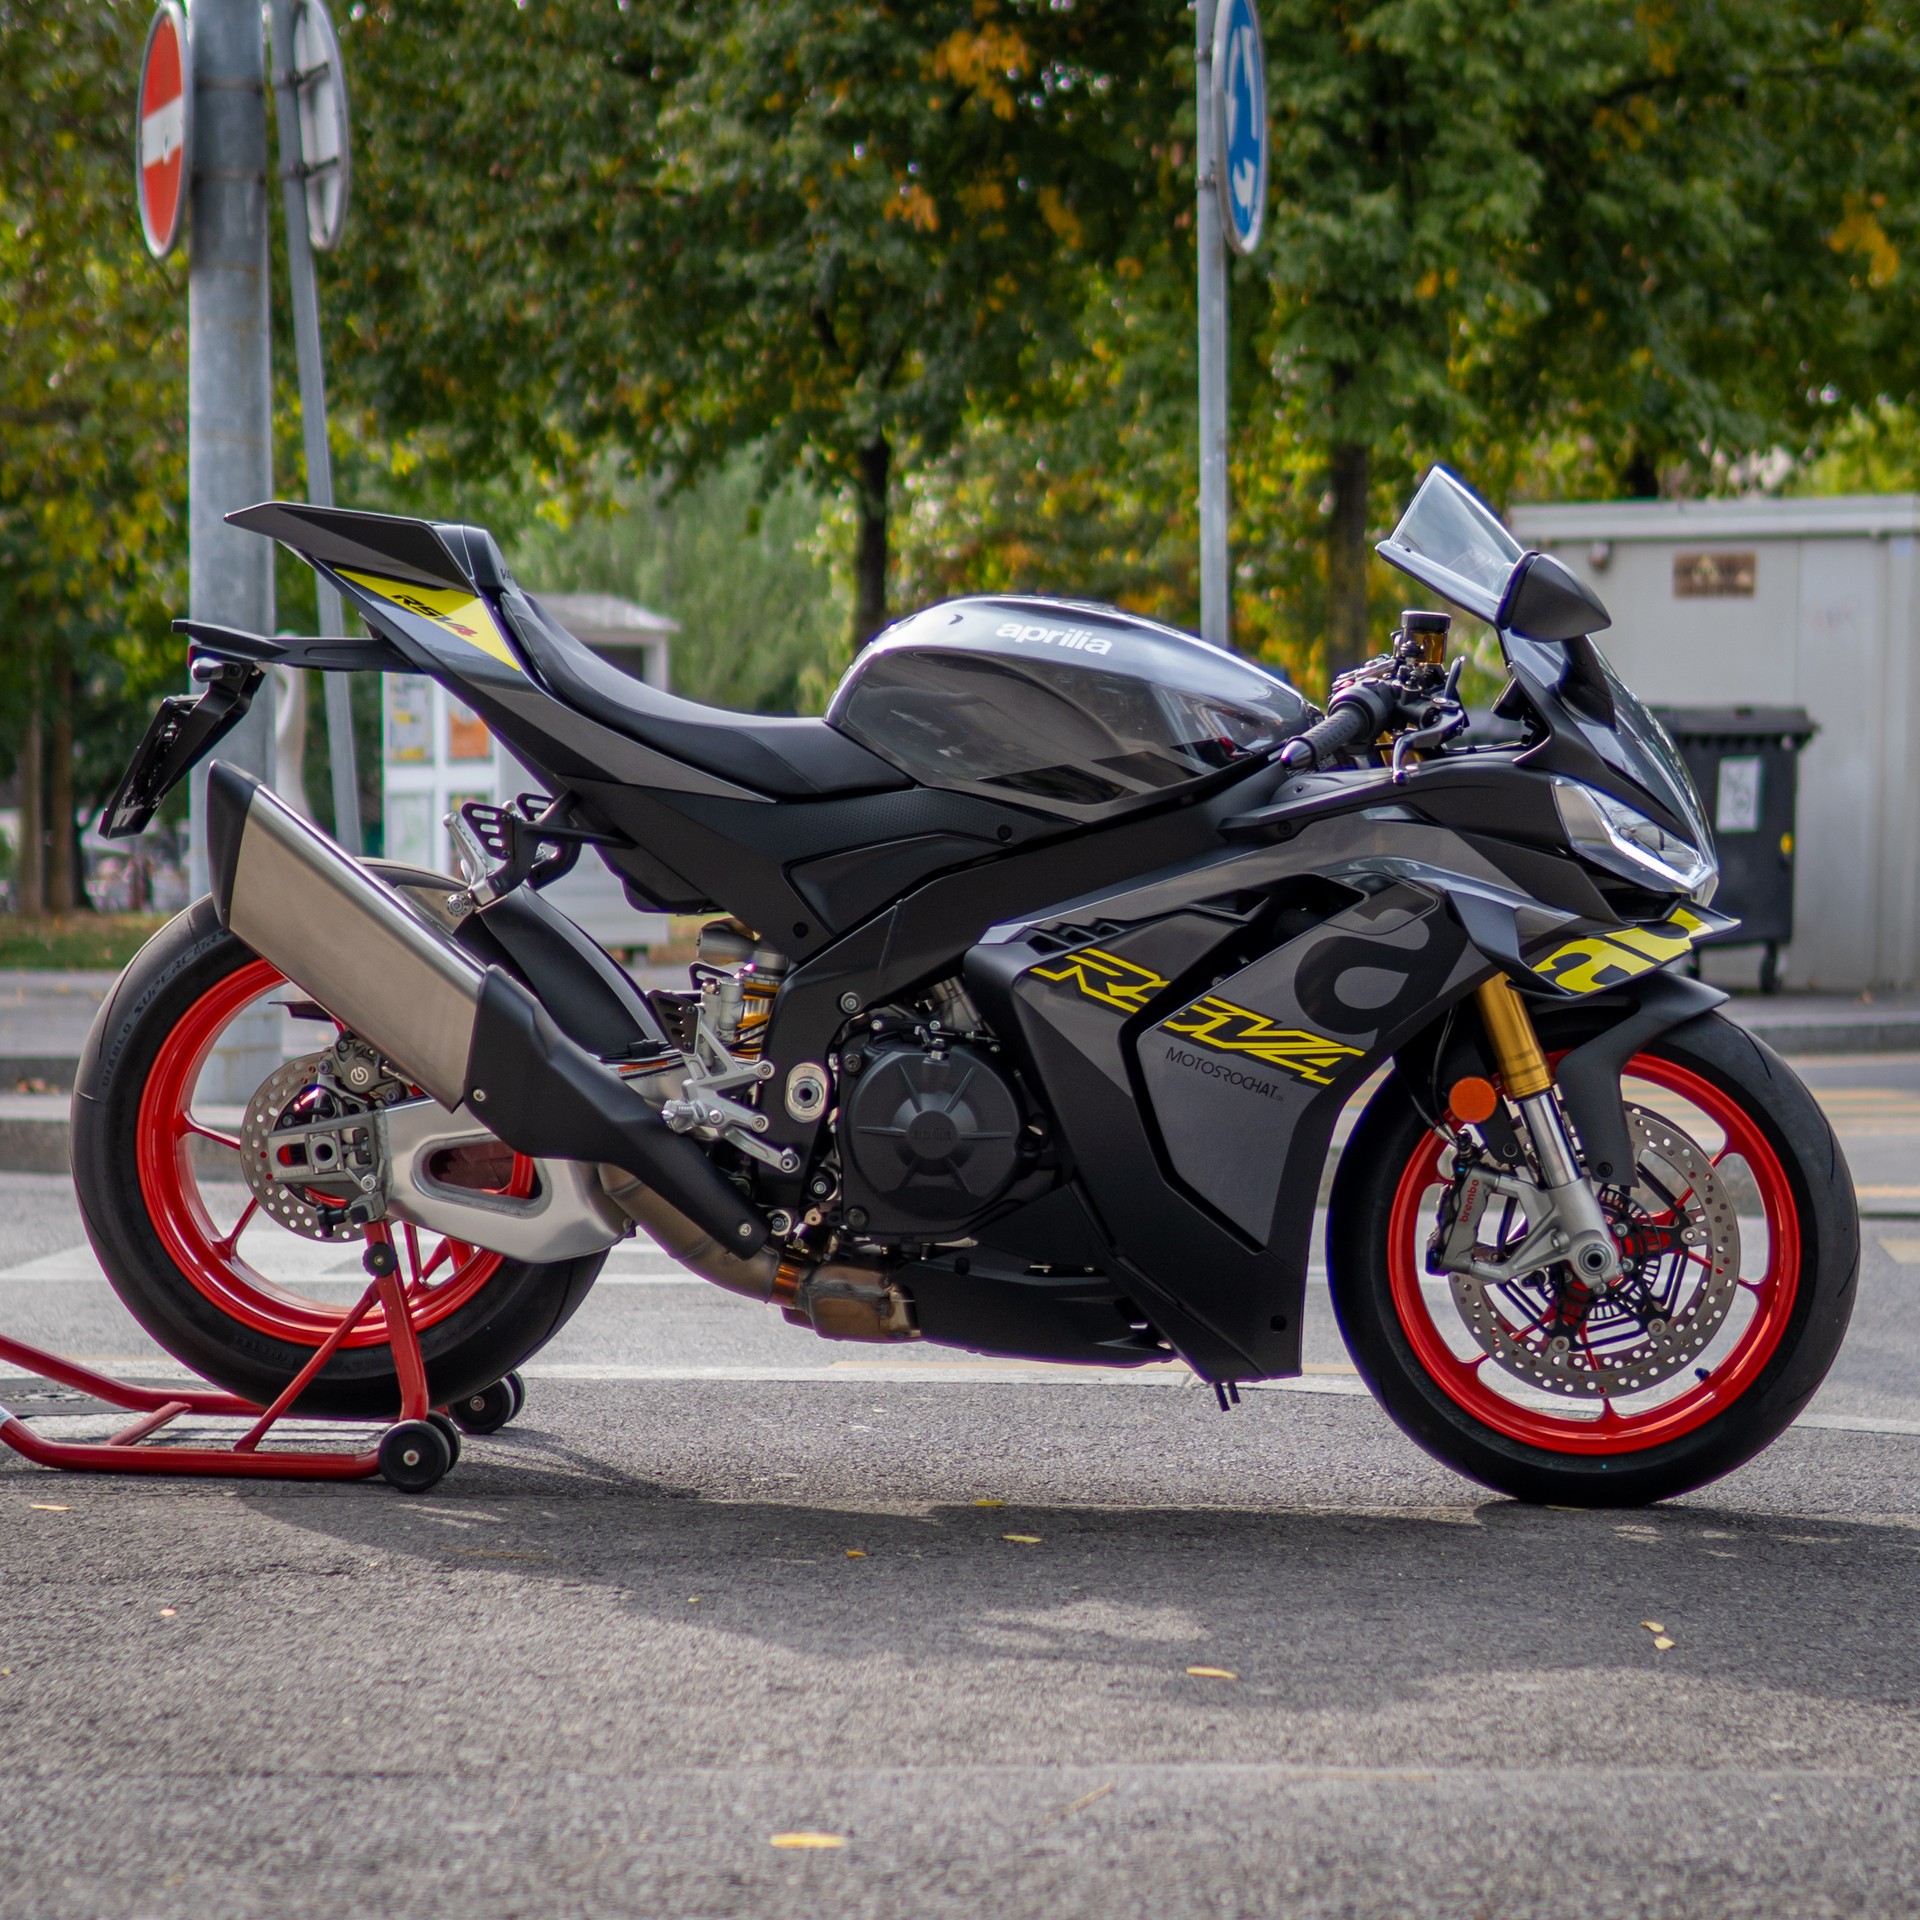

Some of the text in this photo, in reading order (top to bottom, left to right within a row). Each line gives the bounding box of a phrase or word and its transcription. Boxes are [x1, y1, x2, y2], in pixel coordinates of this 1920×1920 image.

[500, 568, 512, 580] V4
[391, 594, 478, 637] RSV4
[995, 622, 1113, 656] aprilia
[1029, 947, 1366, 1085] RSV4
[102, 1022, 132, 1087] DIABLO
[1459, 1179, 1480, 1223] brembo
